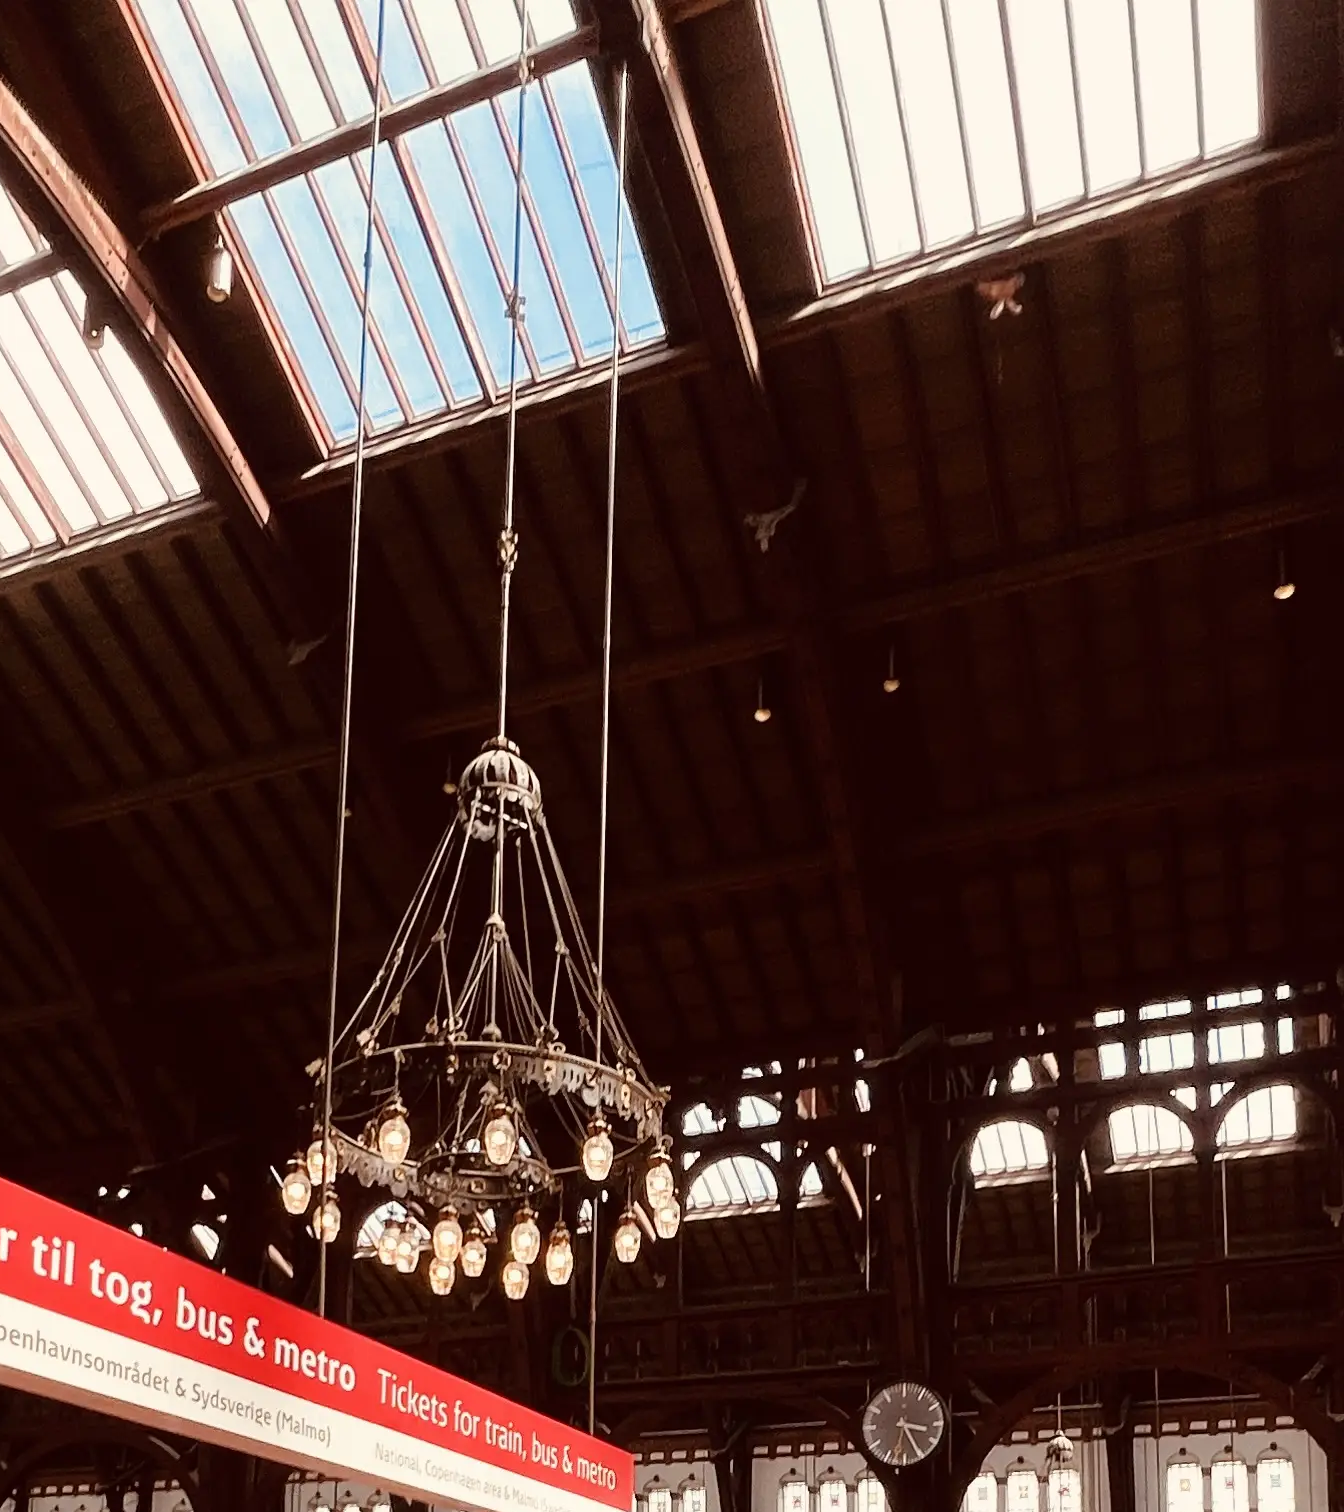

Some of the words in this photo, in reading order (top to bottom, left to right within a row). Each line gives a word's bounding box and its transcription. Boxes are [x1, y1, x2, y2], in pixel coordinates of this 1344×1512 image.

[32, 1236, 75, 1286] til
[89, 1258, 162, 1326] tog,
[175, 1285, 233, 1346] bus
[243, 1317, 266, 1358] &
[274, 1336, 356, 1391] metro
[175, 1378, 186, 1398] &
[191, 1383, 272, 1427] Sydsverige
[377, 1368, 448, 1428] Tickets
[454, 1400, 480, 1438] for
[485, 1416, 527, 1461] train,
[532, 1431, 558, 1470] bus
[562, 1445, 573, 1475] &
[577, 1455, 617, 1491] metro
[375, 1442, 422, 1476] National,
[425, 1459, 481, 1493] Copenhagen
[484, 1481, 502, 1498] area
